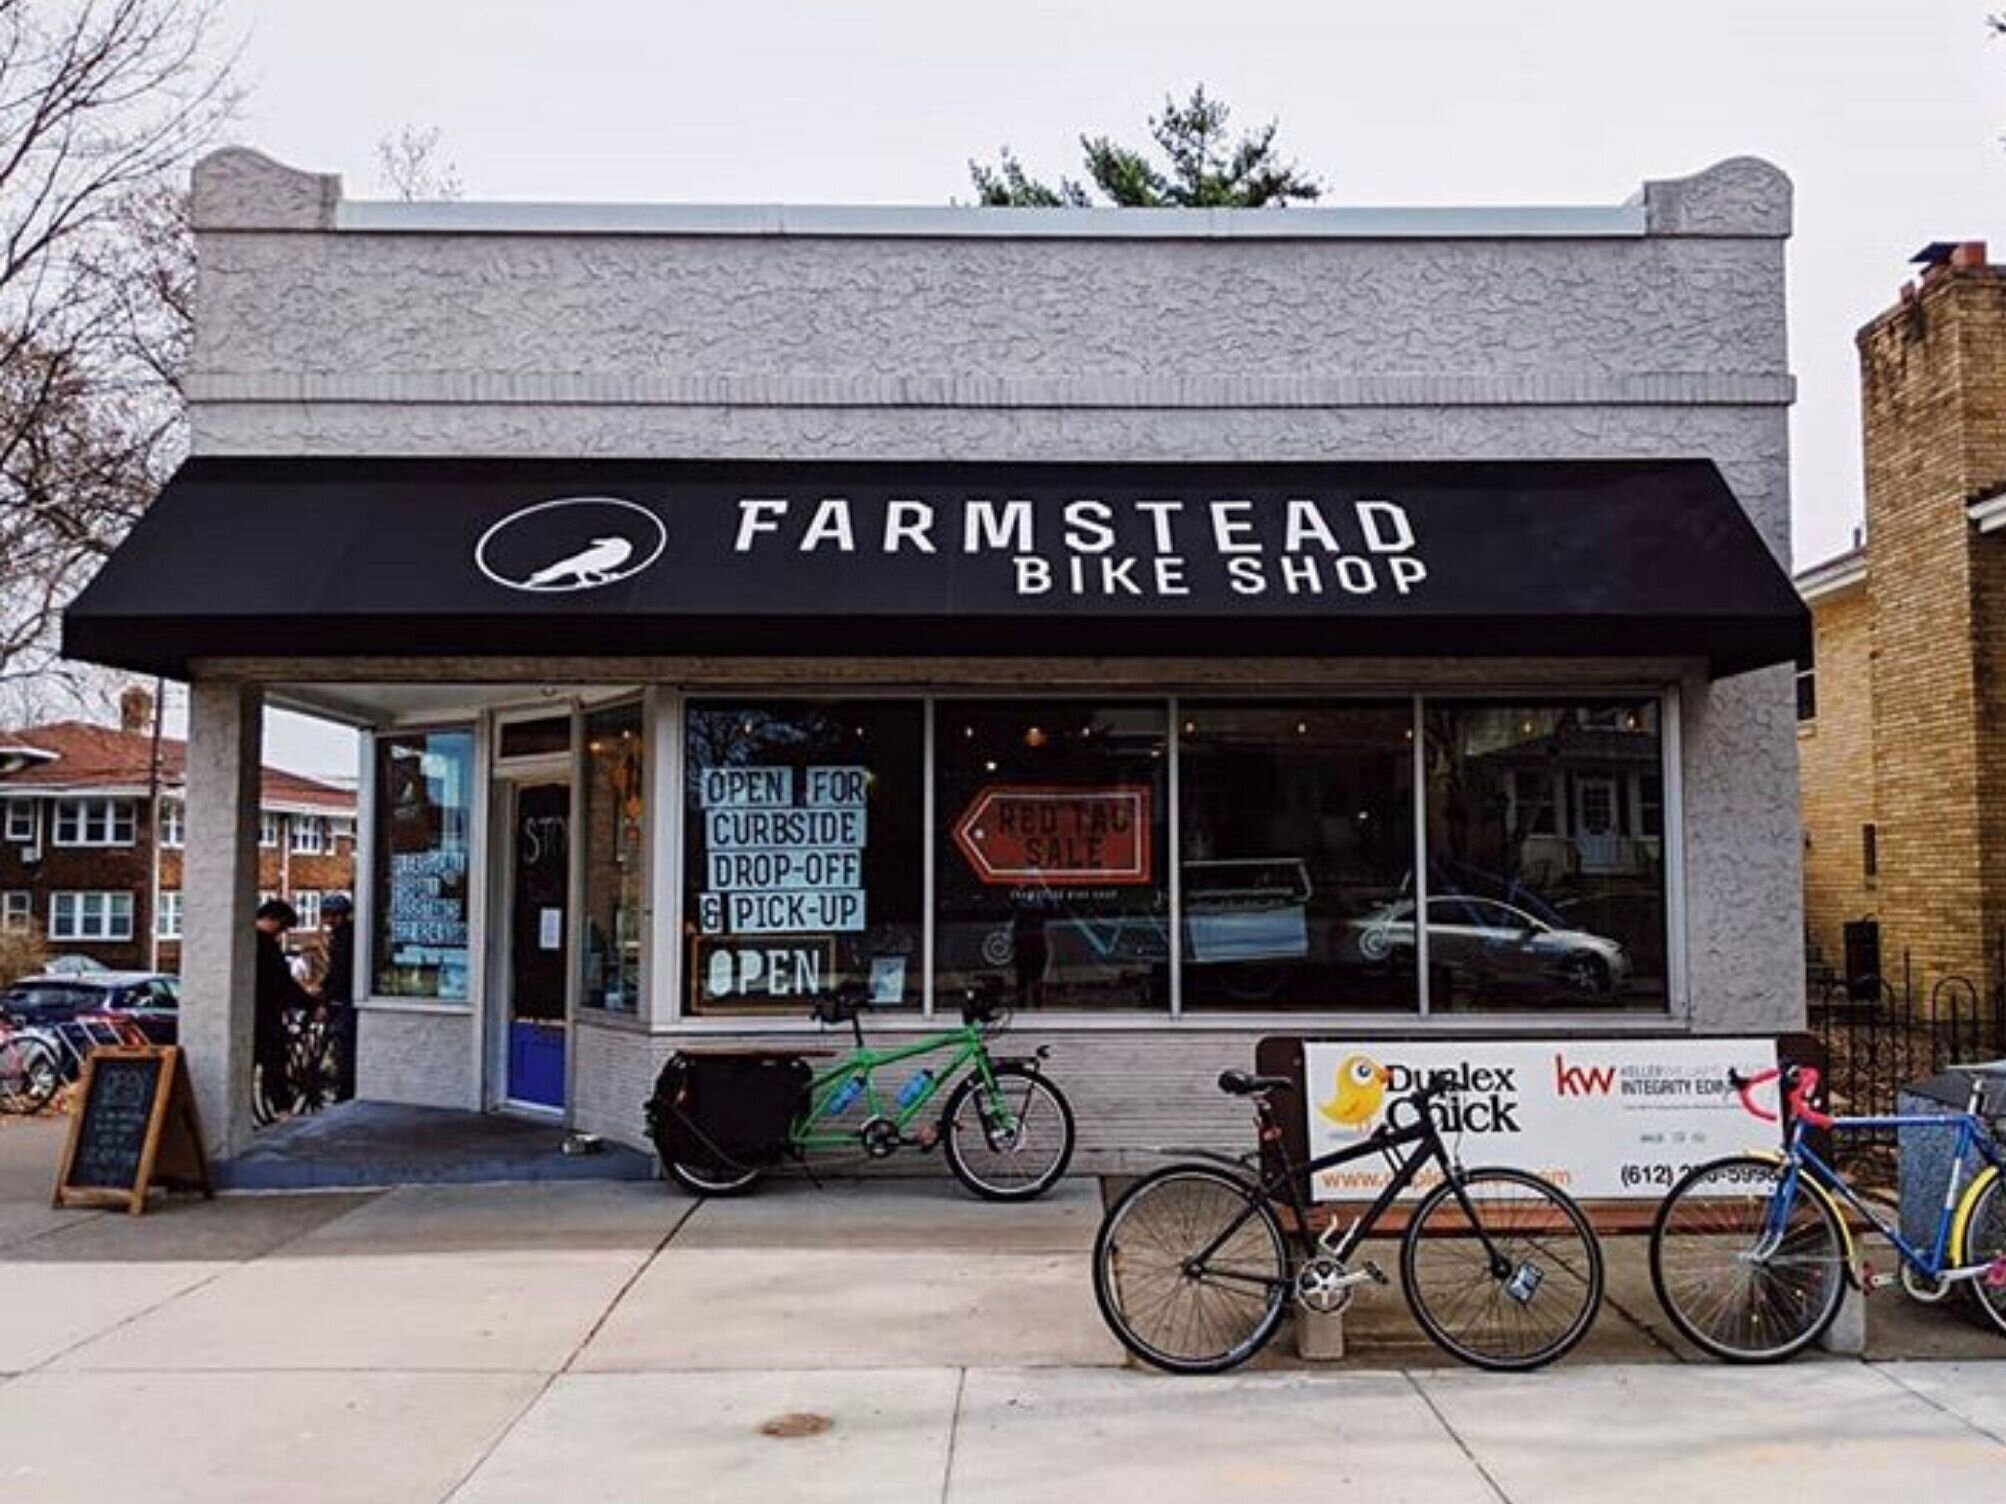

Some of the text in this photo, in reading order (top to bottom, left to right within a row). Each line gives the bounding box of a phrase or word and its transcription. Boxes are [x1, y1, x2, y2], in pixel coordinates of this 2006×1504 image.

[735, 499, 1416, 553] FARMSTEAD
[1013, 555, 1428, 595] BIKE SHOP
[708, 770, 864, 802] OPEN FOR
[713, 812, 857, 845] CURBSIDE
[1025, 838, 1102, 867] SALE
[714, 854, 858, 887] DROP-OFF
[735, 895, 858, 928] PICK-UP
[709, 949, 820, 996] OPEN
[1555, 1054, 1616, 1097] kw
[1620, 1079, 1692, 1095] INTEGRITY
[1621, 1164, 1674, 1187] (612)
